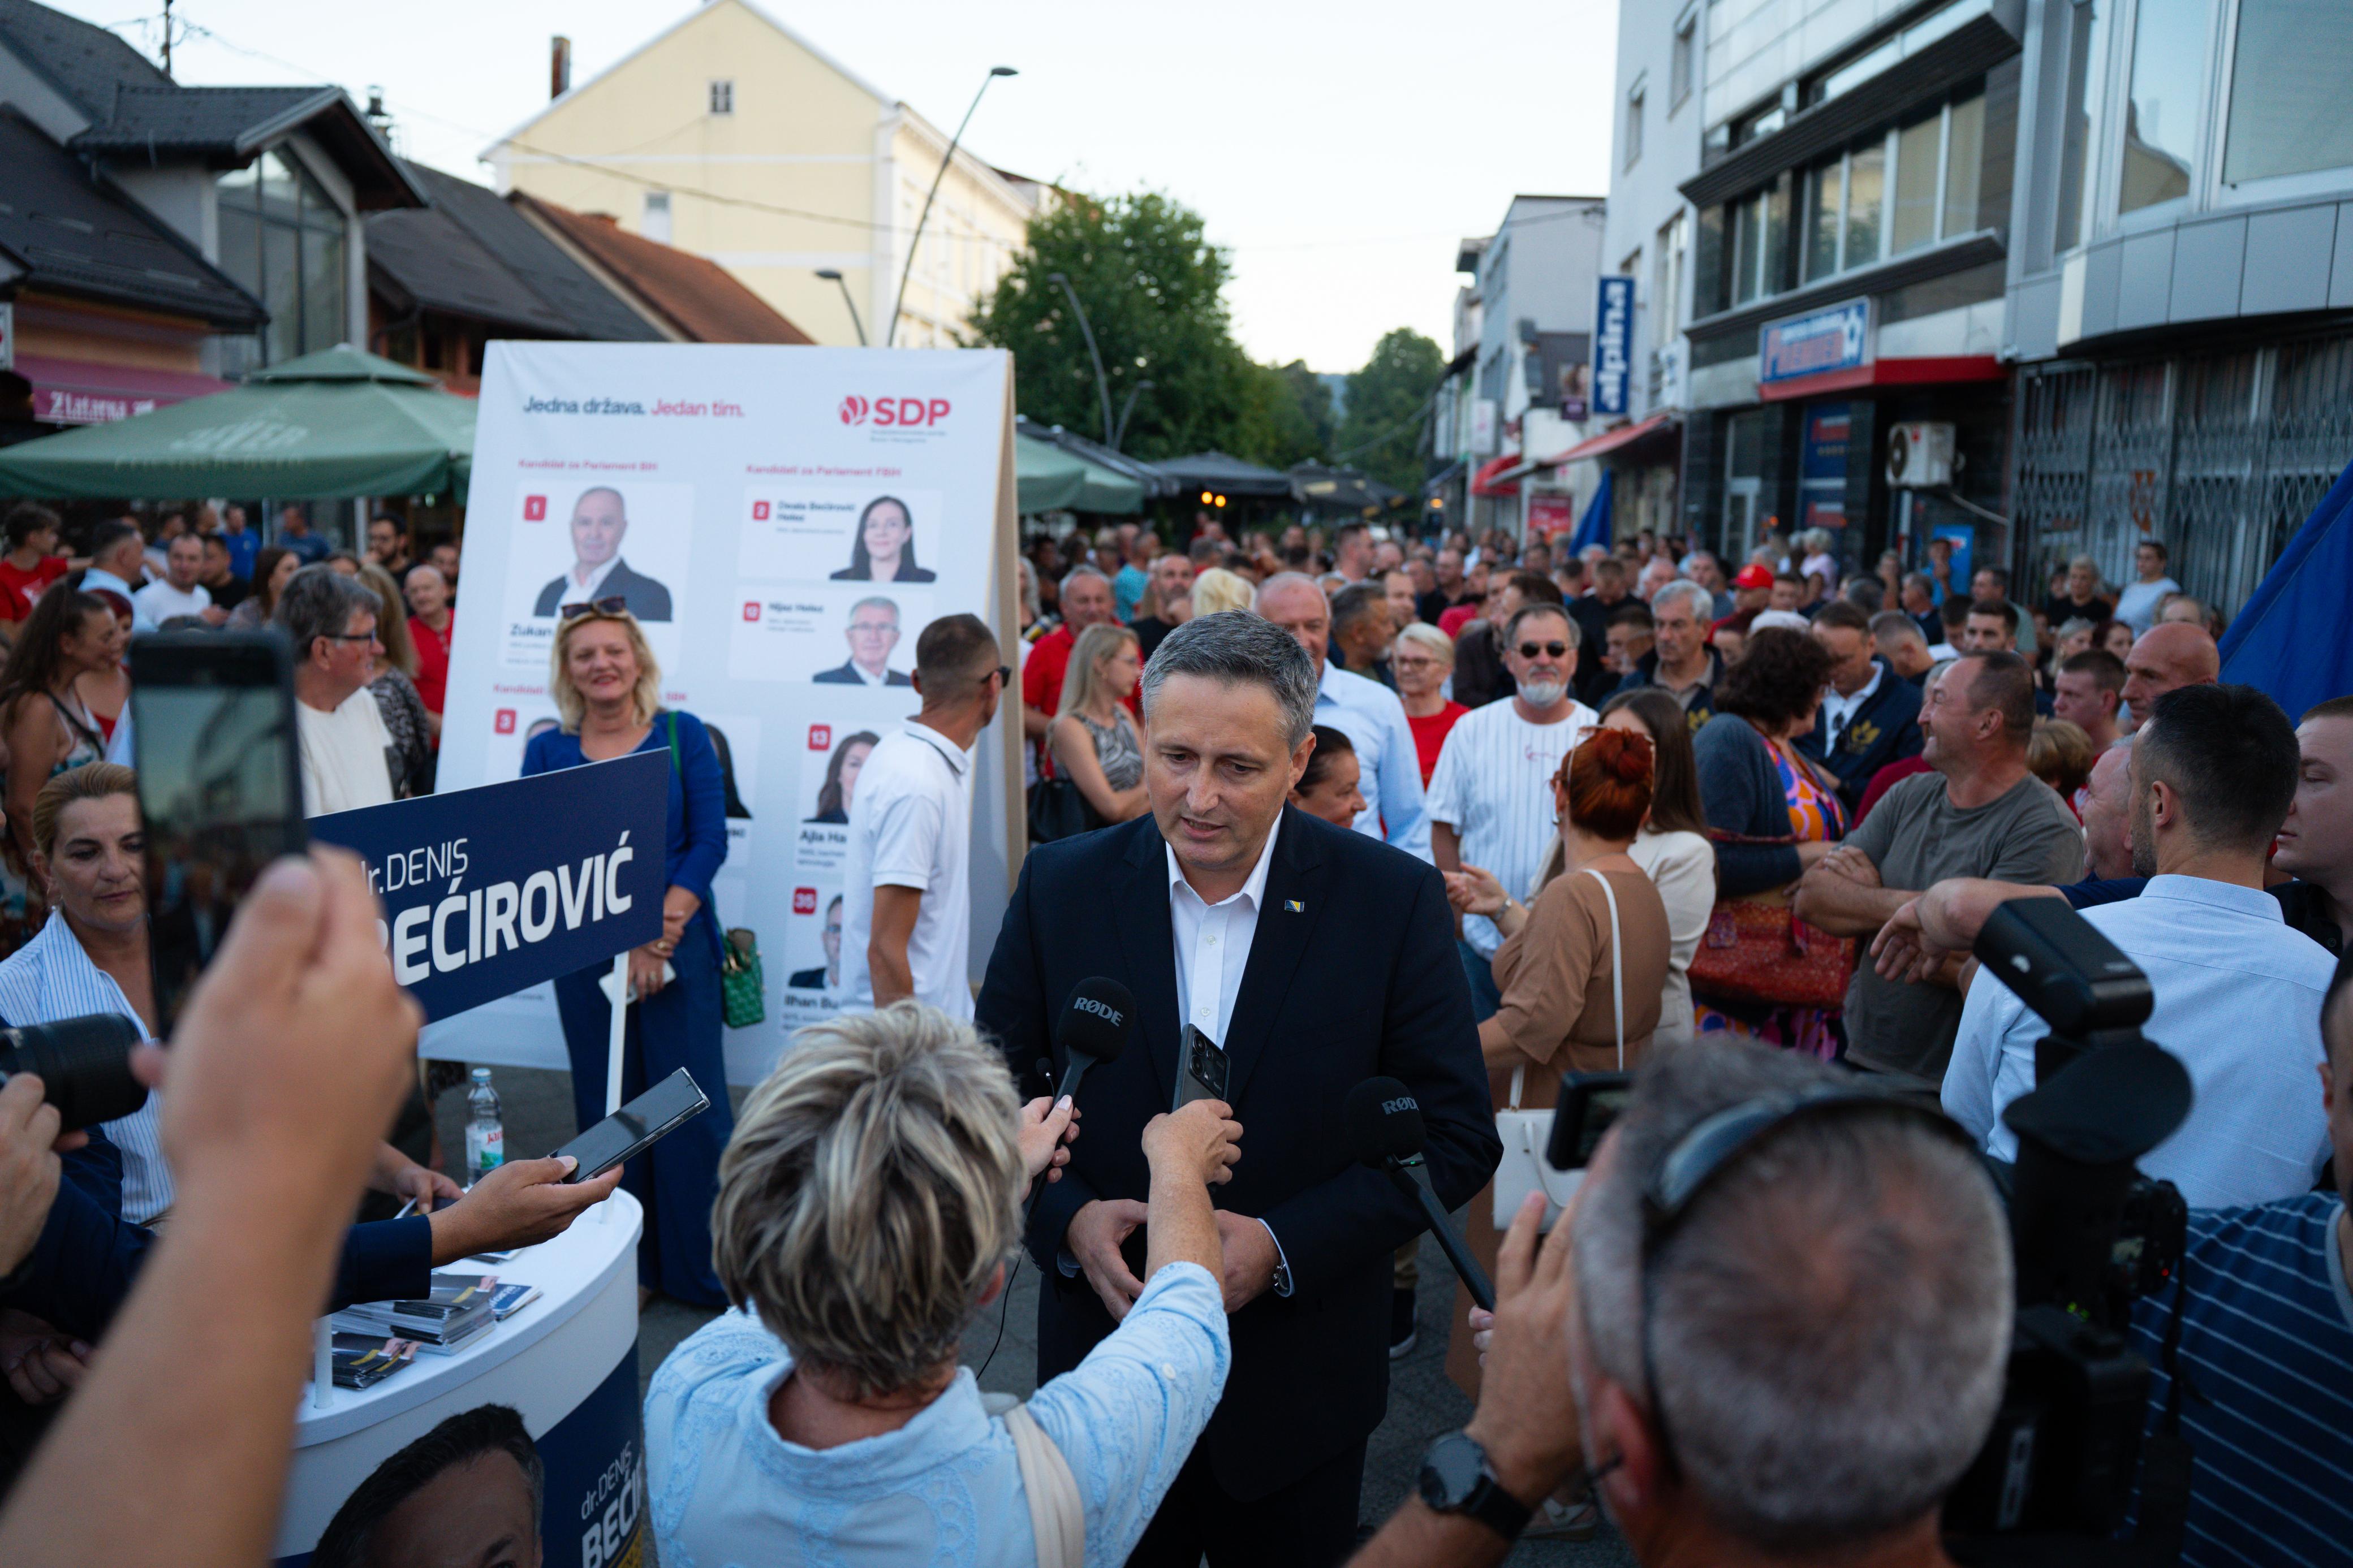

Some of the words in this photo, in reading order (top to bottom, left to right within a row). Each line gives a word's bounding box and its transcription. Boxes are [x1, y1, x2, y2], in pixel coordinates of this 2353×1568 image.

[523, 396, 579, 414] Jedna
[583, 397, 645, 415] država.
[651, 398, 707, 416] Jedan
[712, 400, 745, 417] tim.
[873, 397, 951, 426] SDP
[376, 830, 634, 986] EĆIROVIĆ
[1074, 997, 1123, 1027] RØDE
